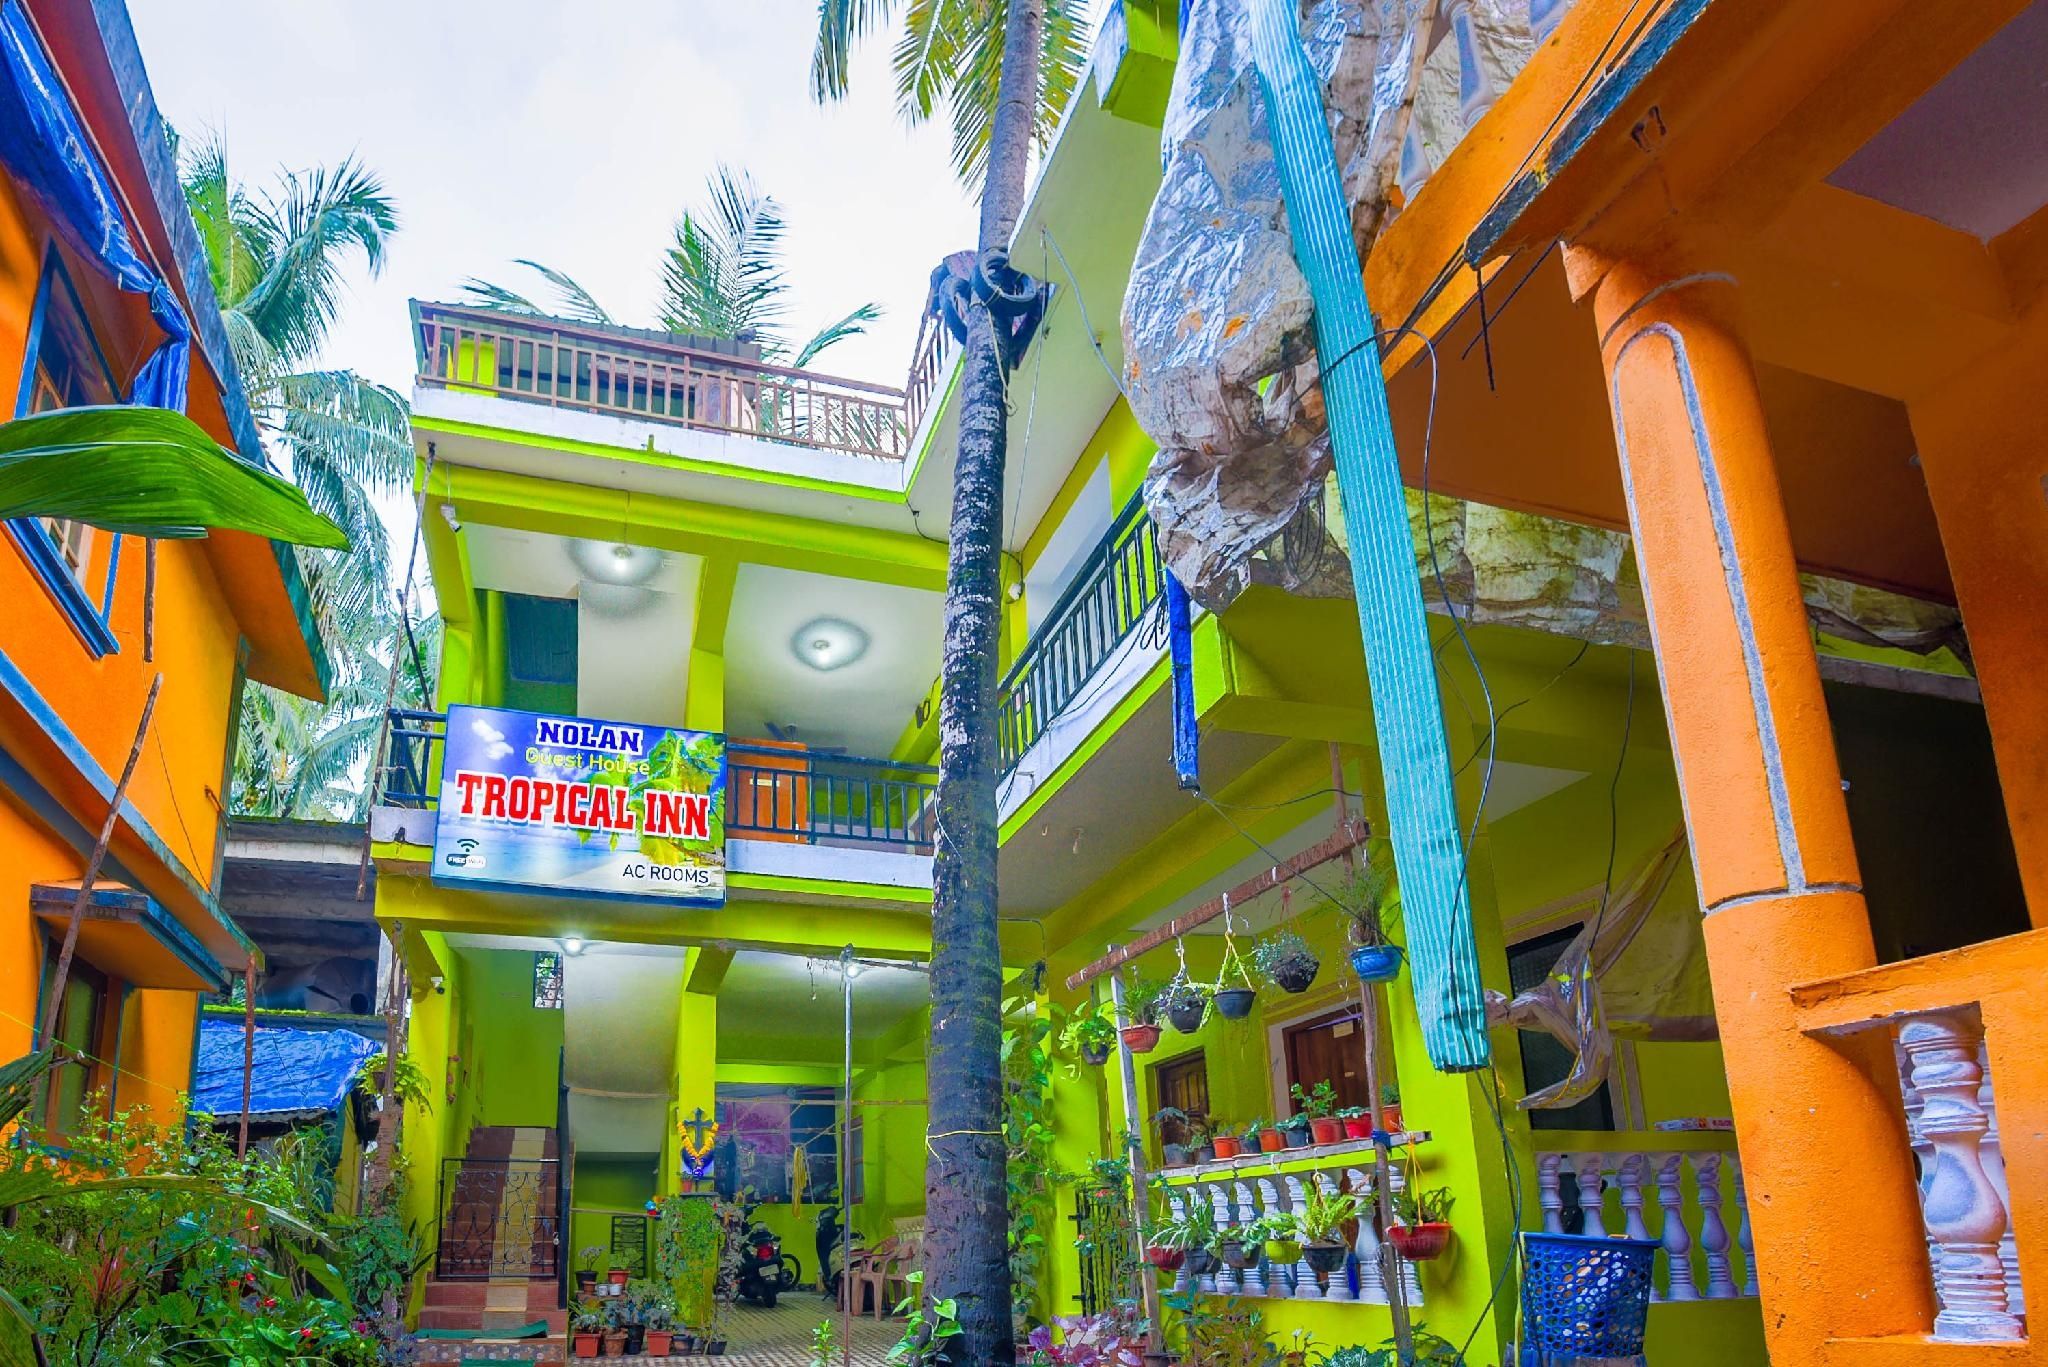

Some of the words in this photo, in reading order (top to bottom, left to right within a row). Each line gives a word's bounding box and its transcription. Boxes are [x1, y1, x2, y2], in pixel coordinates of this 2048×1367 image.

[538, 720, 641, 753] NOLAN
[525, 747, 583, 768] Guest
[589, 754, 650, 775] House
[457, 773, 634, 831] TROPICAL
[644, 792, 709, 839] INN
[622, 864, 645, 879] AC
[650, 866, 709, 883] ROOMS
